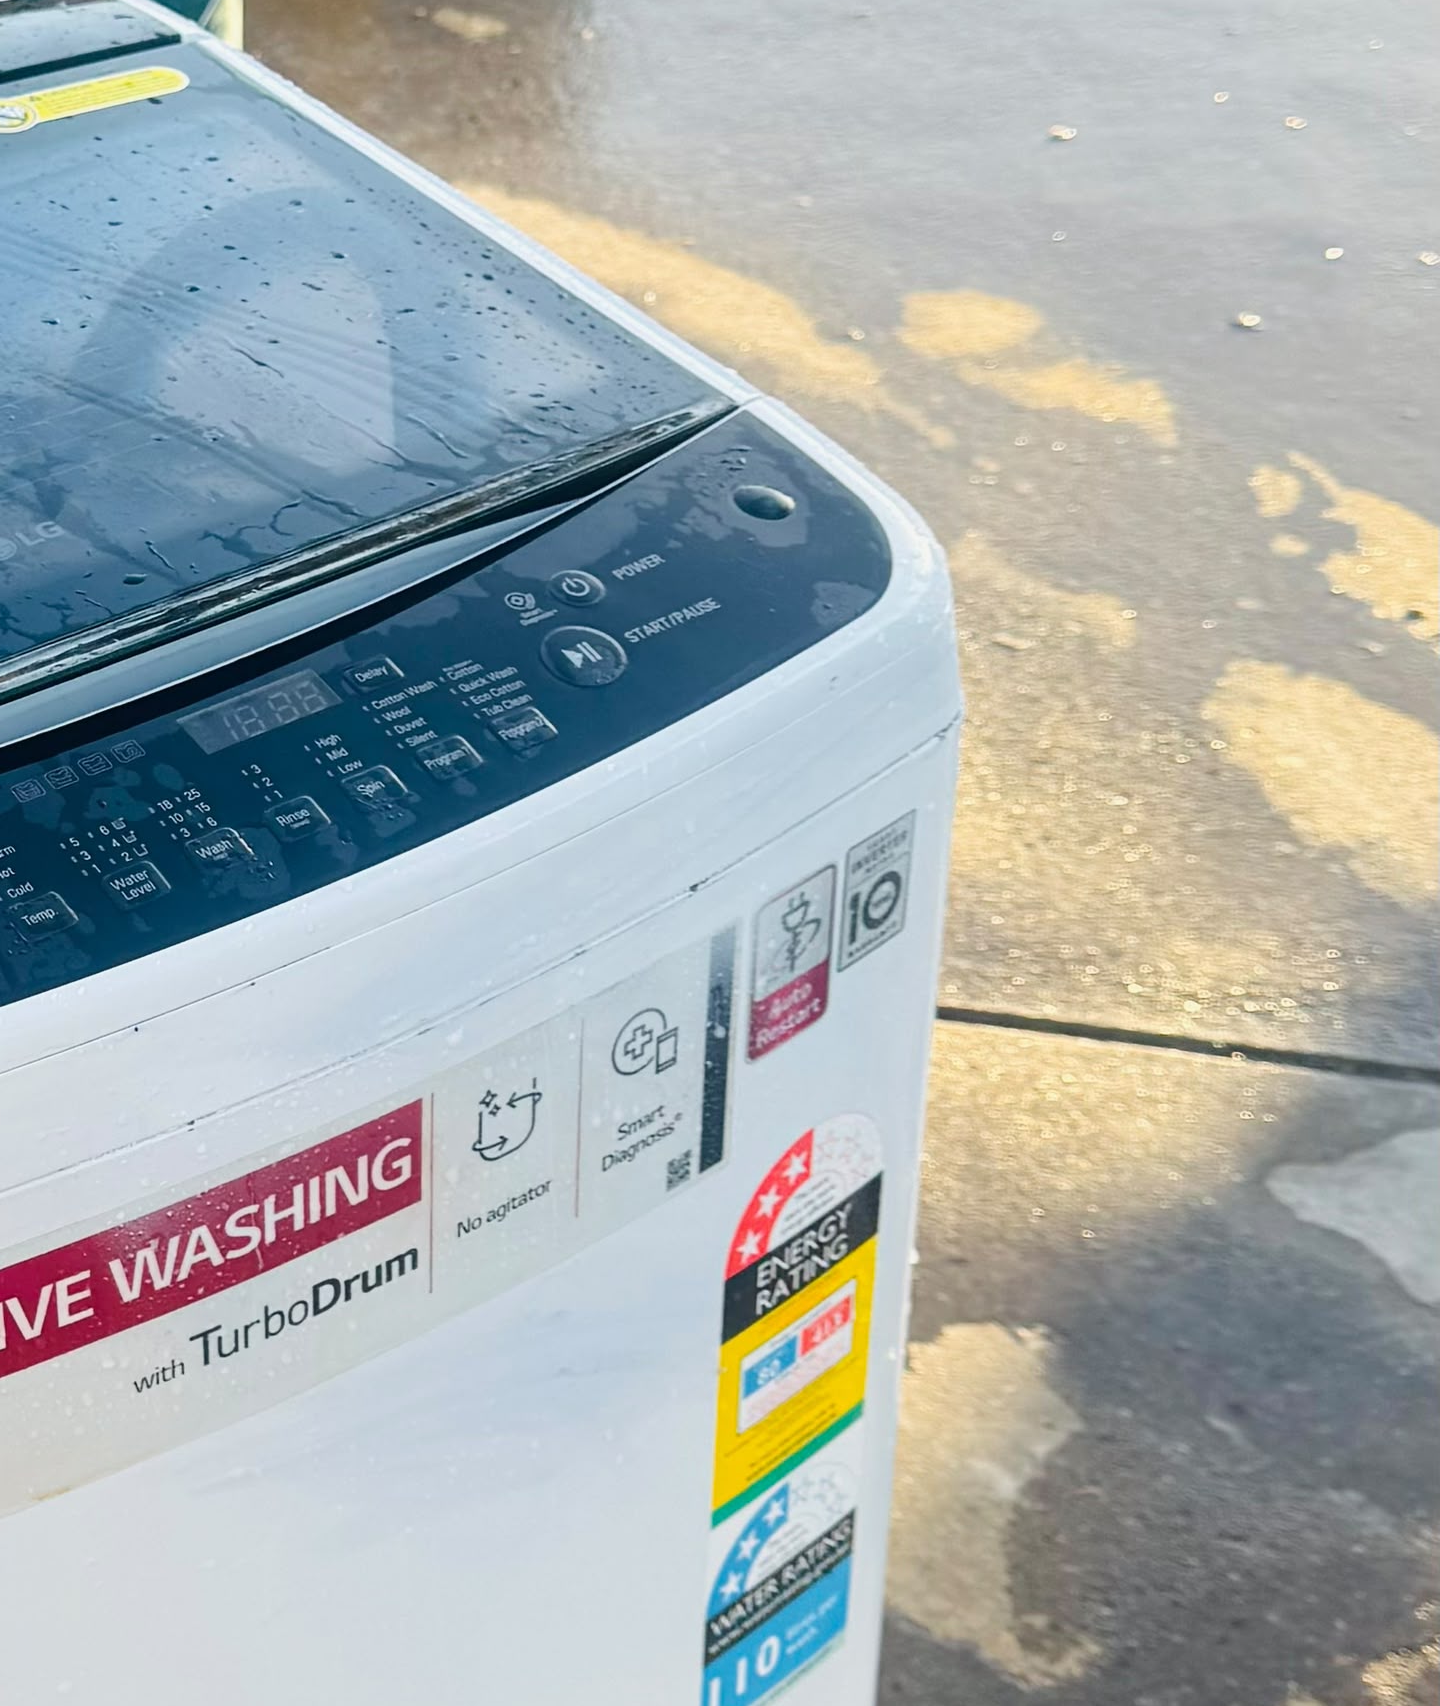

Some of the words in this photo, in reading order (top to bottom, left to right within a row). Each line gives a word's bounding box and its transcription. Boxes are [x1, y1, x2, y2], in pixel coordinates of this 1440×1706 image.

[15, 521, 64, 547] LG
[612, 553, 666, 580] POWER
[624, 597, 722, 643] START/PAUSE
[354, 664, 389, 683] Delay
[446, 663, 484, 680] Cotton
[458, 677, 490, 693] Quick
[486, 666, 518, 682] Wash
[371, 691, 408, 710] Cotton
[405, 680, 438, 698] Wash
[469, 691, 494, 705] Eco
[490, 679, 527, 698] Cotton
[382, 706, 412, 722] Wool
[481, 701, 504, 717] Tub
[502, 693, 534, 710] Clean
[394, 717, 427, 735] Duvet
[315, 733, 342, 749] High
[405, 729, 439, 747] Silent
[325, 747, 349, 761] Mid
[424, 746, 470, 771] Program1
[250, 764, 262, 775] 3
[337, 759, 363, 775] Low
[262, 777, 274, 788] 2
[356, 779, 386, 798] Spin
[157, 799, 174, 812] 18
[183, 788, 201, 801] 25
[273, 790, 283, 799] 1
[168, 812, 184, 825] 10
[195, 801, 211, 814] 15
[275, 808, 310, 827] Rinse
[68, 836, 80, 847] 5
[98, 825, 110, 836] 6
[180, 827, 191, 838] 3
[206, 817, 218, 827] 6
[80, 850, 91, 861] 3
[111, 838, 121, 848] 4
[195, 838, 234, 859] Wash
[92, 864, 101, 873] 1
[121, 851, 133, 862] 2
[7, 881, 34, 899] Cold
[110, 869, 150, 891] Water
[121, 880, 156, 901] Level
[21, 906, 59, 927] Temp.
[849, 870, 902, 945] 10
[767, 982, 813, 1021] Auto
[754, 997, 822, 1049] Restart
[617, 1105, 665, 1141] Smart
[456, 1215, 482, 1238] No
[485, 1179, 553, 1223] agitator
[110, 1137, 413, 1305] WASHING
[757, 1202, 852, 1288] ENERGY
[756, 1232, 849, 1315] RATING
[133, 1359, 185, 1393] with
[189, 1248, 418, 1366] TurboDrum
[710, 1577, 779, 1636] WATER
[781, 1519, 853, 1585] RATING
